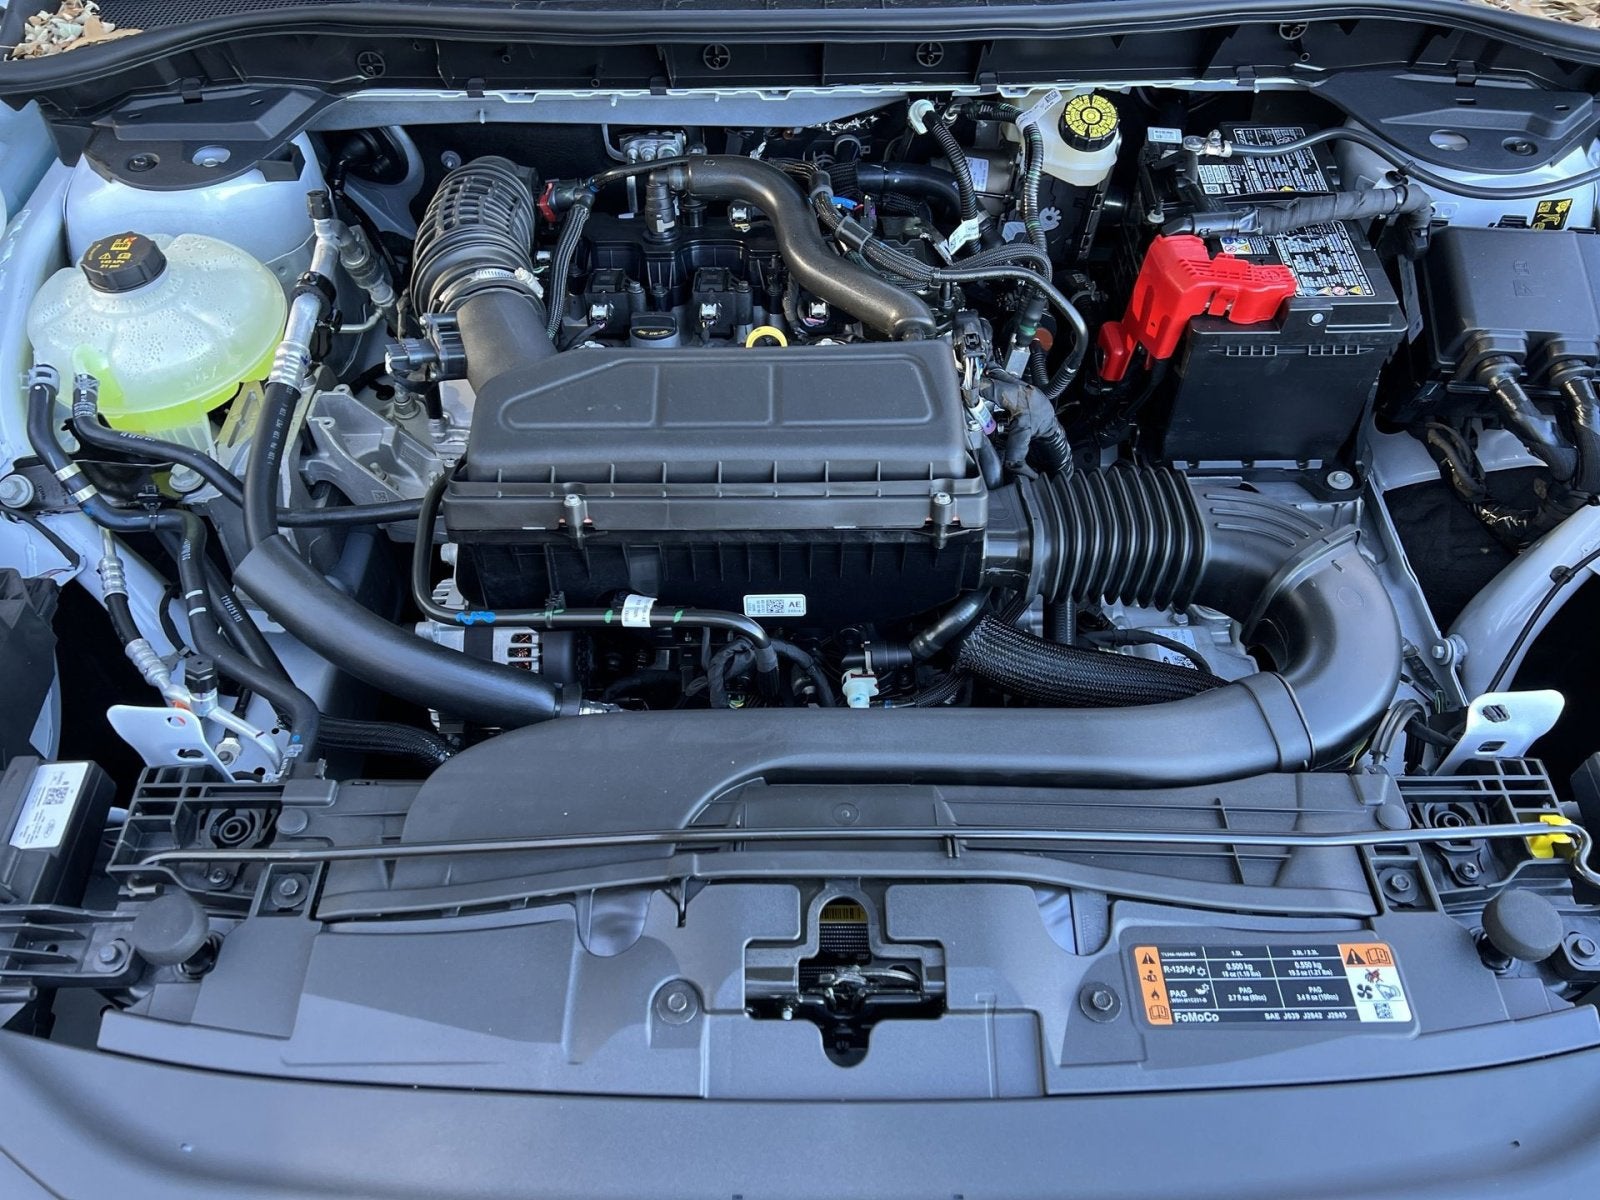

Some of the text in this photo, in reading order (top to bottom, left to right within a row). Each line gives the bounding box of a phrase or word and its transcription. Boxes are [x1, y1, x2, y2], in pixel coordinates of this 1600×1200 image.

[1163, 965, 1196, 975] R-1234yf
[1243, 962, 1254, 972] kg
[1312, 961, 1322, 970] kg
[1169, 990, 1188, 998] PAG
[1174, 1012, 1220, 1022] FoMoCo
